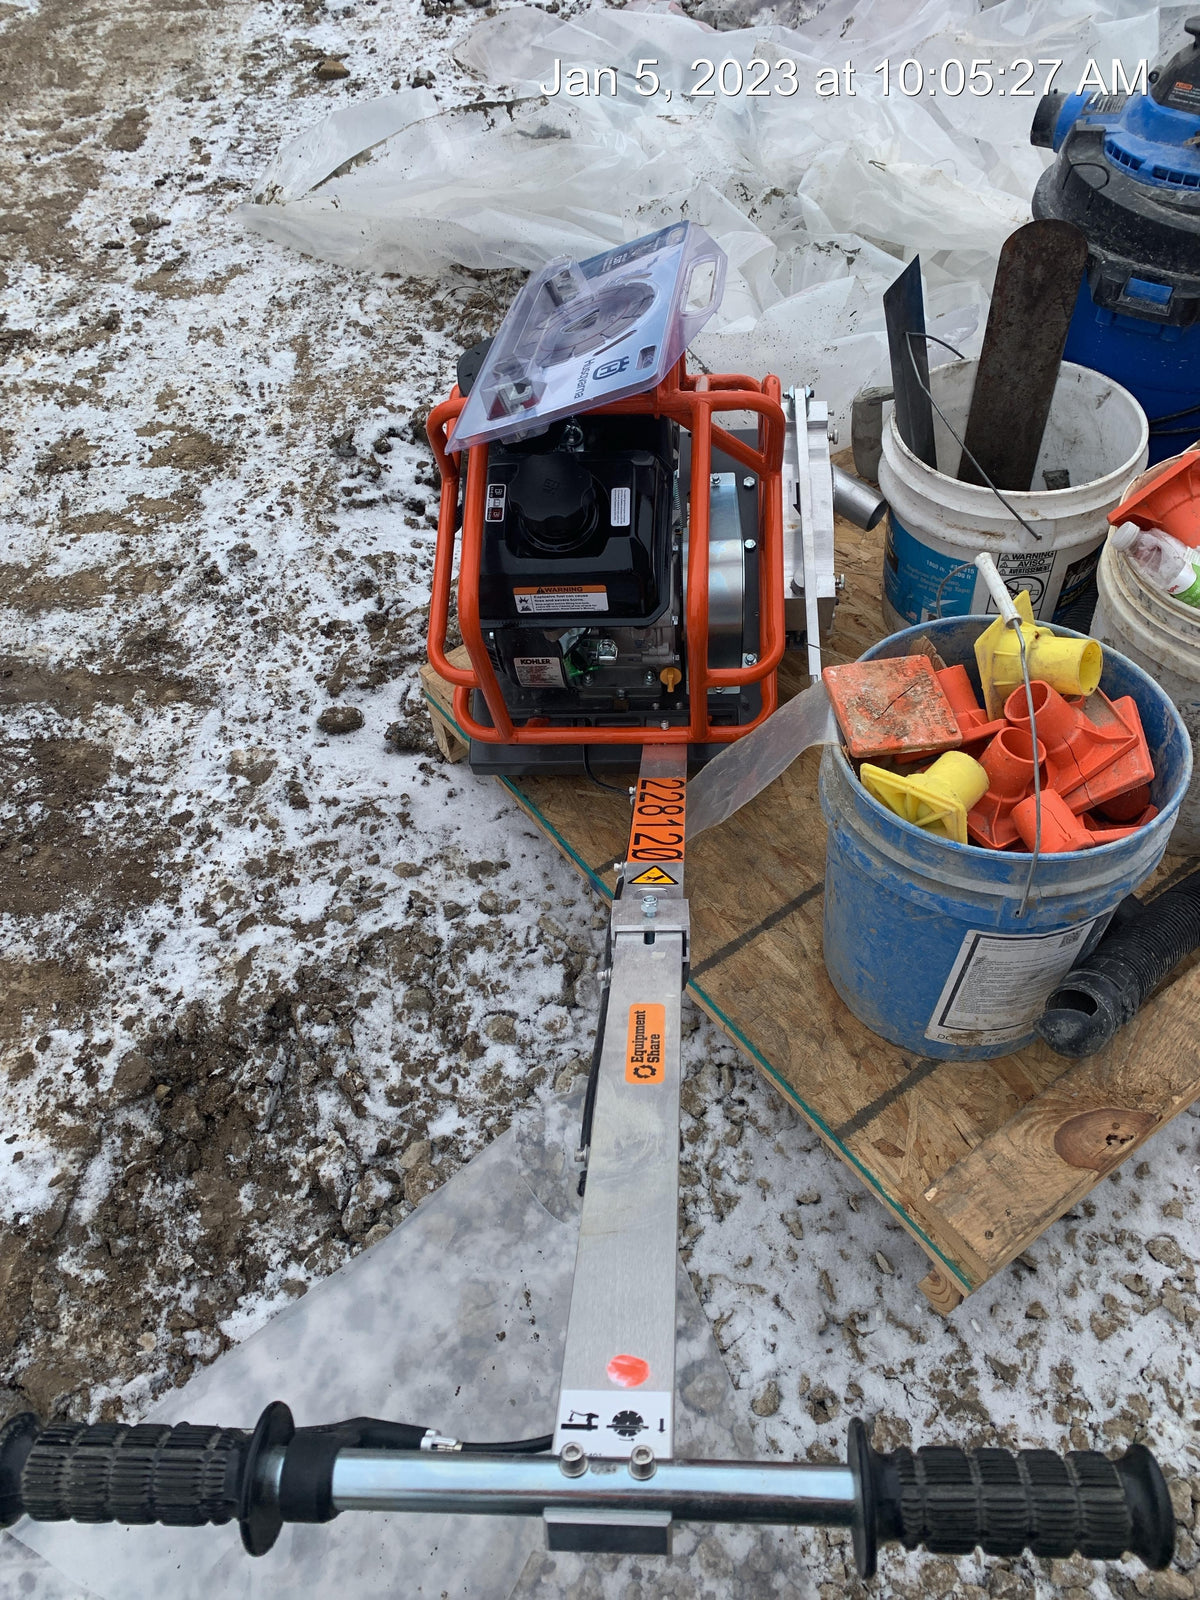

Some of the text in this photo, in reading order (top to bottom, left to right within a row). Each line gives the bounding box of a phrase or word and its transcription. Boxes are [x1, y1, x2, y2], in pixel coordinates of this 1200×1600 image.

[574, 358, 595, 399] Husqvarna
[1012, 550, 1054, 560] WARNING
[1017, 559, 1045, 567] AVISO
[631, 779, 685, 861] 228120
[631, 1010, 648, 1063] Equipment
[647, 1033, 660, 1063] Share
